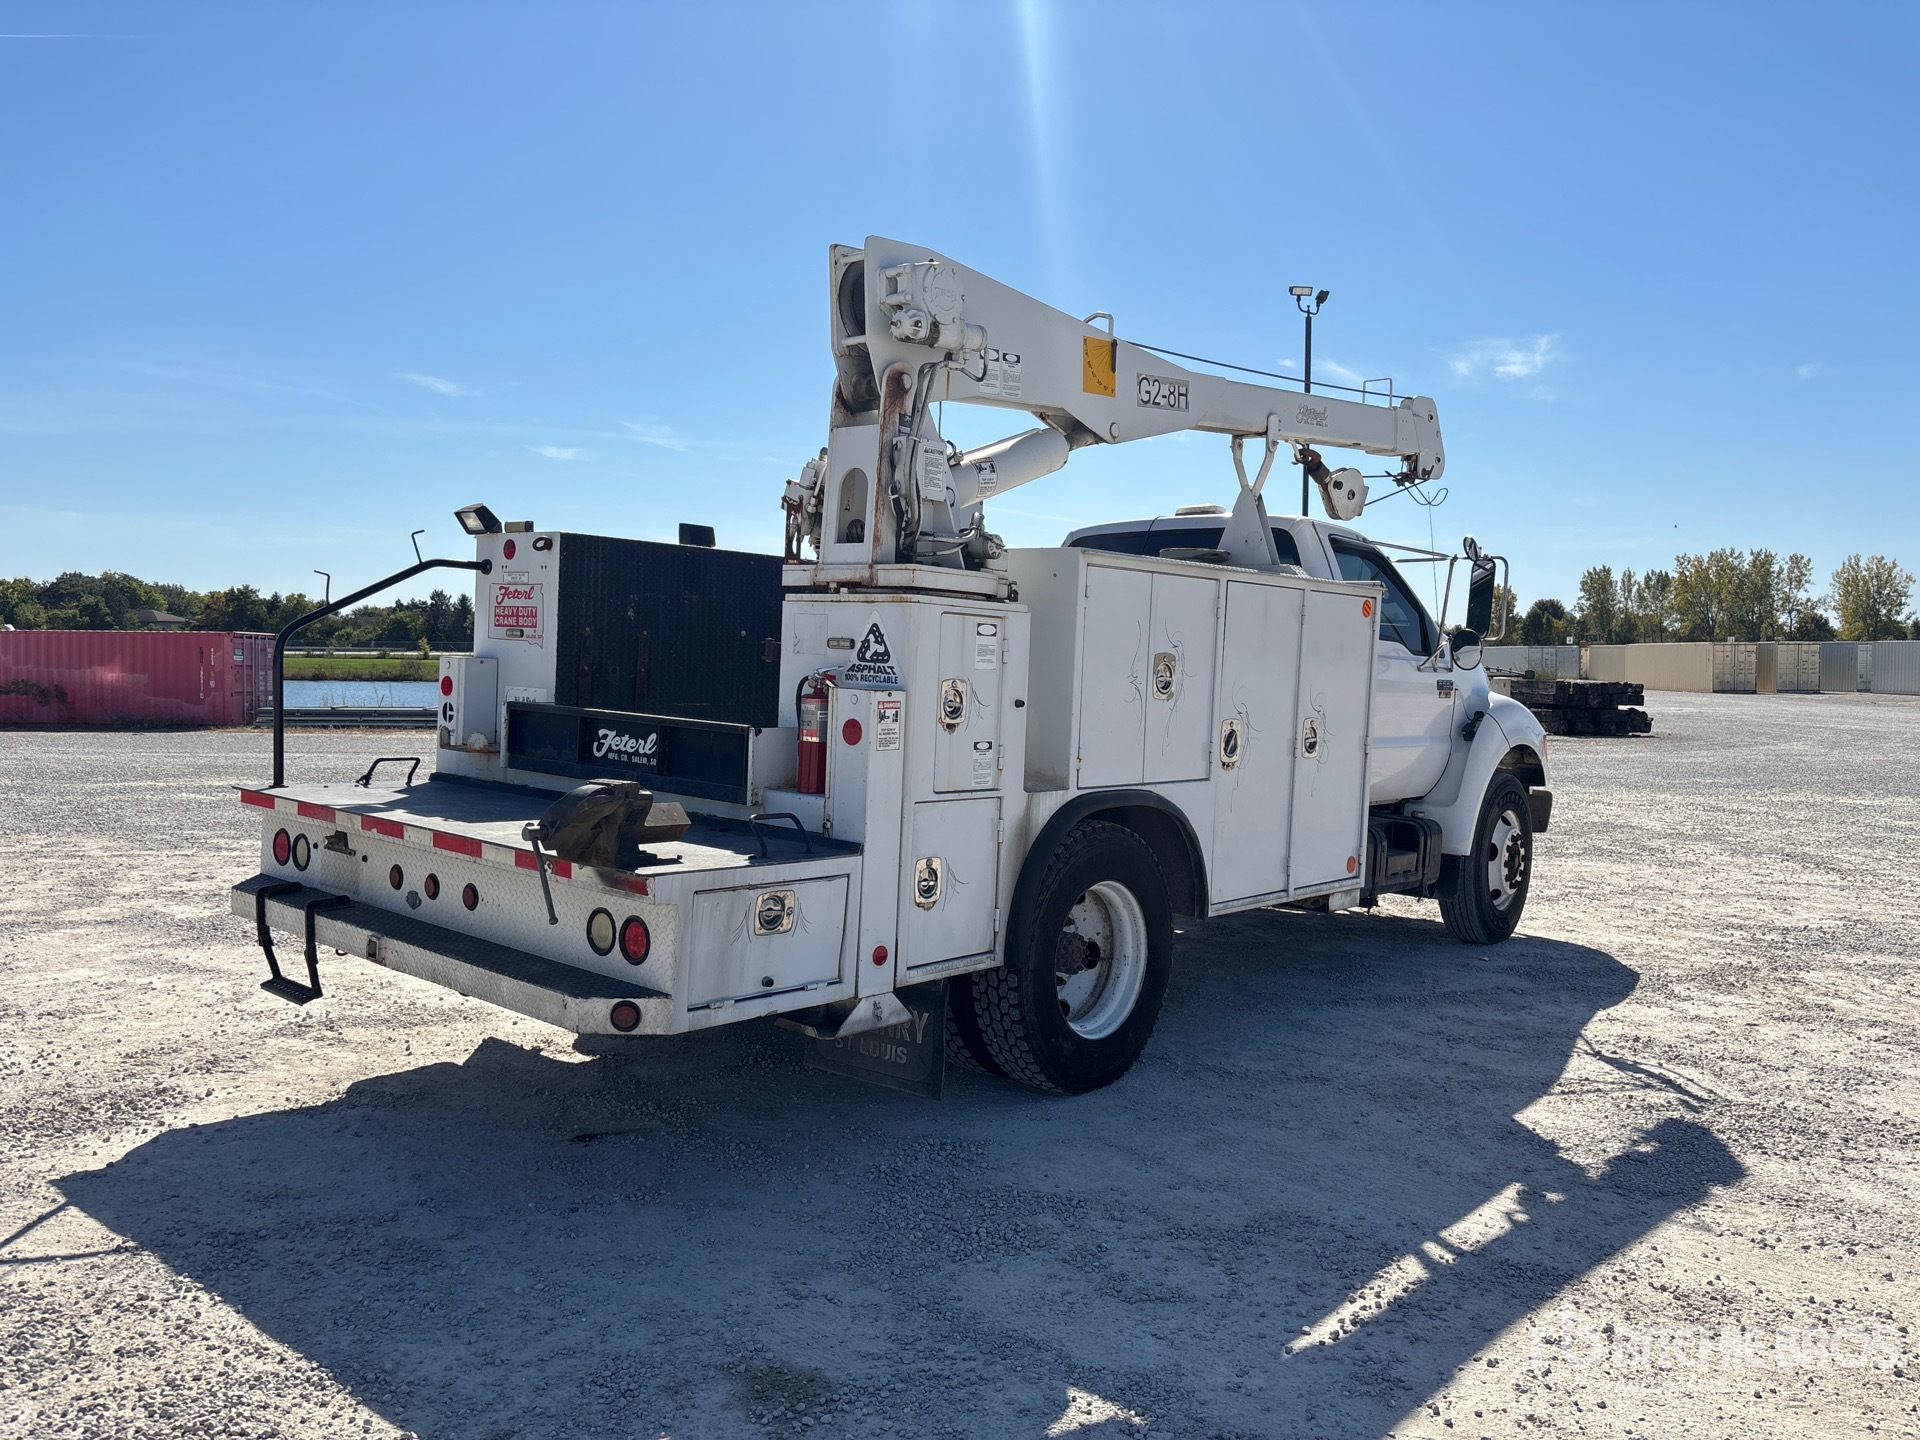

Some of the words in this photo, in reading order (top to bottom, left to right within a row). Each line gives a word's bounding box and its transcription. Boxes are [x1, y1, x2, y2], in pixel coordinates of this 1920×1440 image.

[1138, 376, 1188, 409] G2-8H
[495, 607, 517, 616] HEAVY
[518, 607, 537, 616] DUTY
[494, 616, 517, 626] CRANE
[518, 617, 537, 626] BODY
[846, 663, 897, 675] ASPHALT
[844, 673, 859, 682] 100%
[860, 674, 899, 684] RECYCLABLE
[631, 755, 649, 765] SALEM,
[859, 1037, 908, 1065] LOUIS
